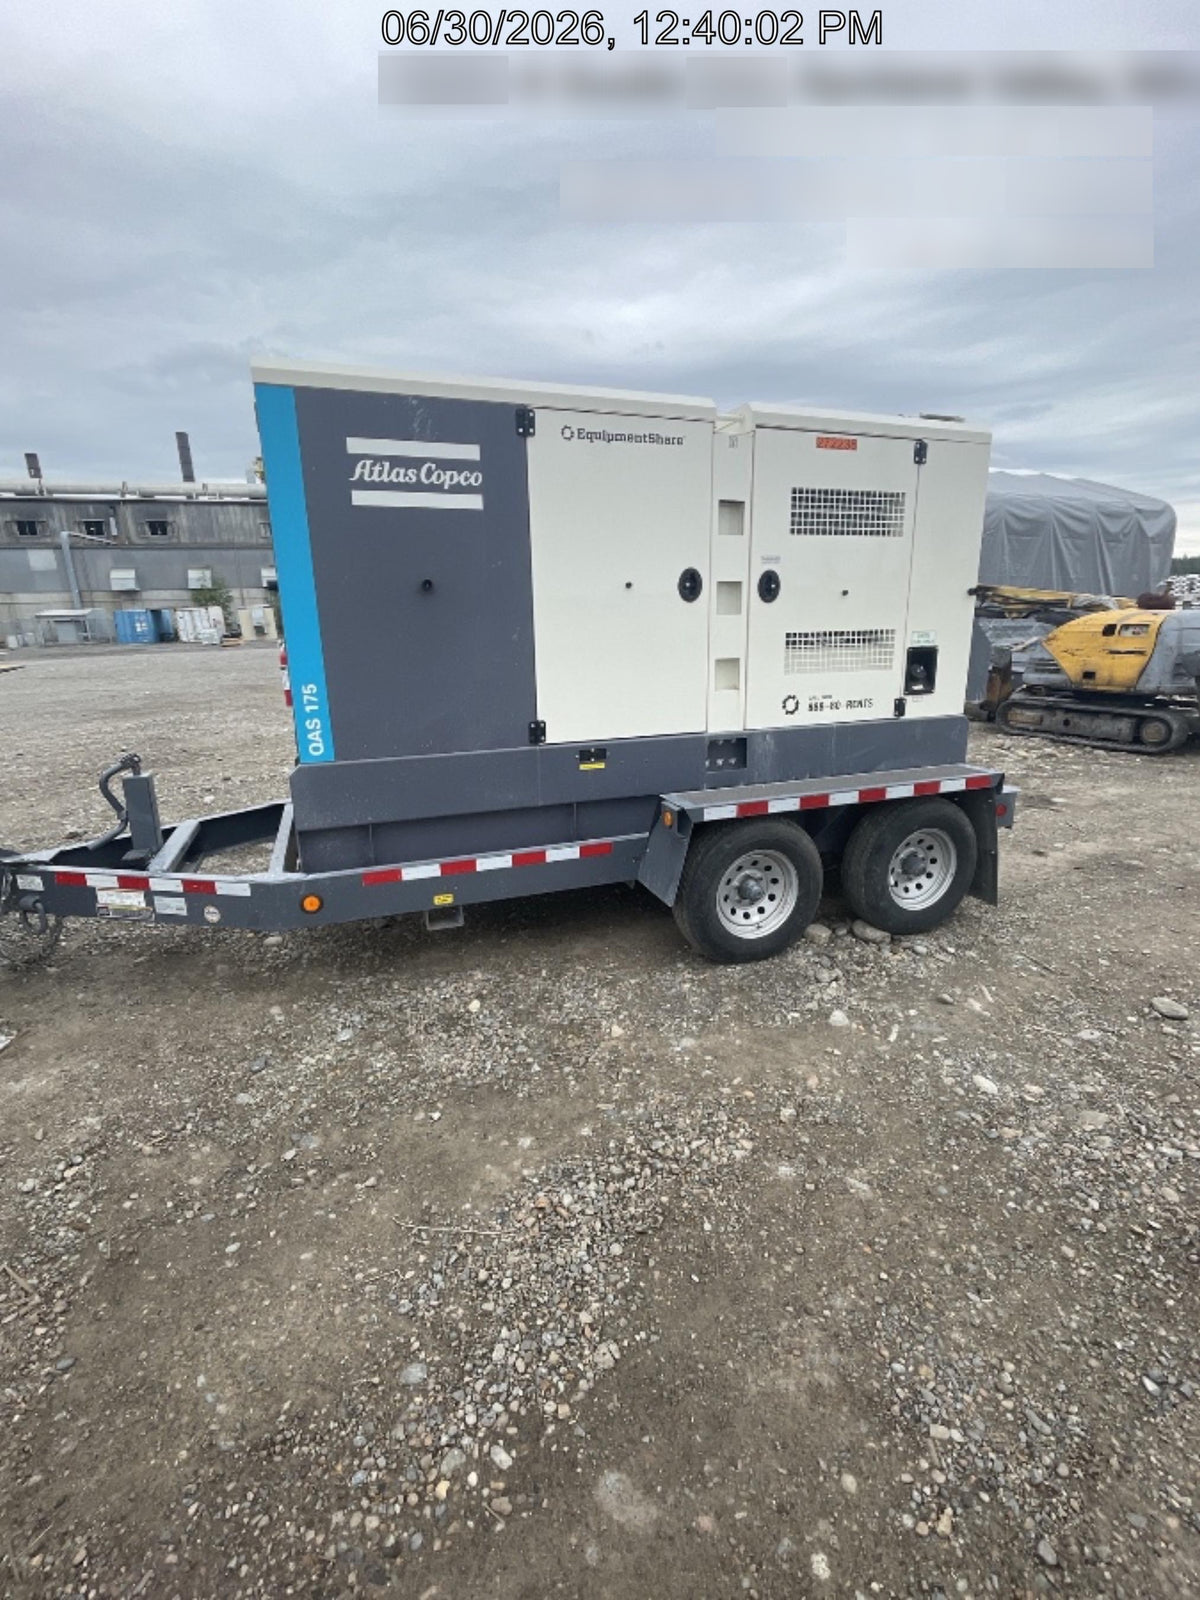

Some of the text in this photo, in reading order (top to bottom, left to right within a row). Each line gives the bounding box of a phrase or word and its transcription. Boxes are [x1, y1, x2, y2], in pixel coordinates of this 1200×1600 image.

[577, 428, 684, 445] EquipmentShare
[349, 459, 483, 489] Atlas Copco
[301, 683, 325, 756] QAS 175
